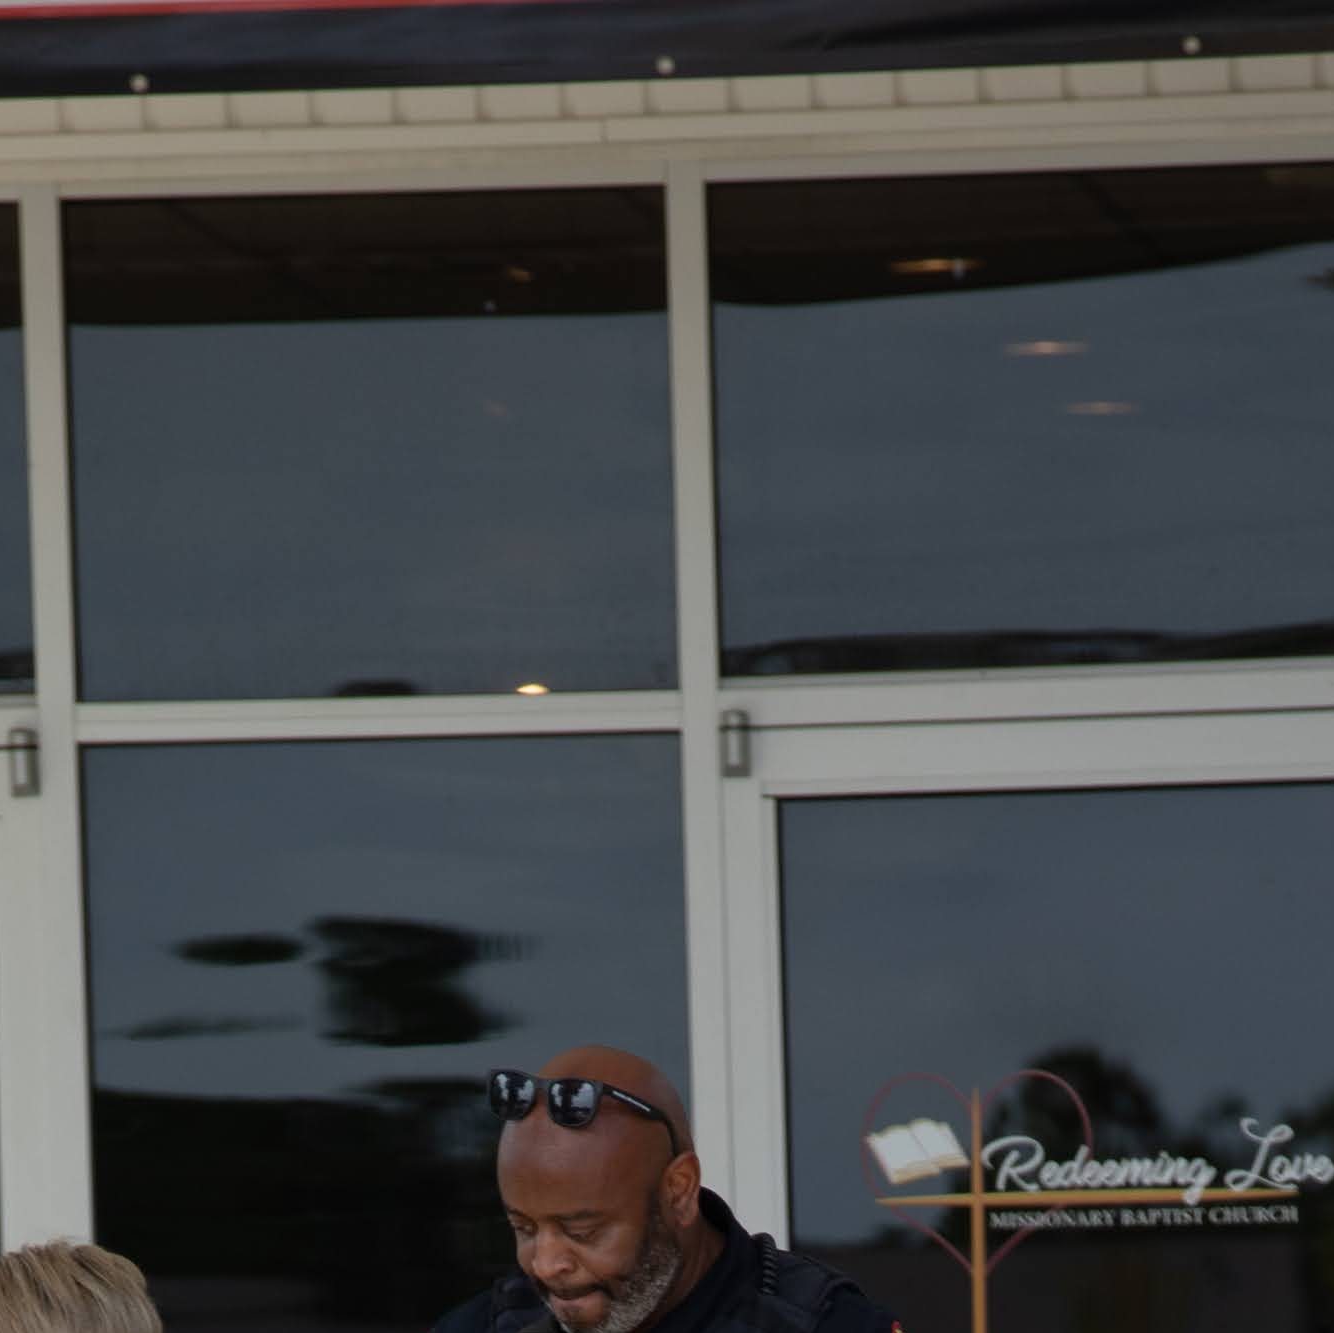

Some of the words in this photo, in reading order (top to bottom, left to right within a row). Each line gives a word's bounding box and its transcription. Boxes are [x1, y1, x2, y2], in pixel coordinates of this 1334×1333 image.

[981, 1135, 1216, 1206] Redeeming
[990, 1208, 1116, 1230] MISSIONARY
[1121, 1207, 1205, 1227] BAPTIST
[1208, 1205, 1300, 1226] CHURCH
